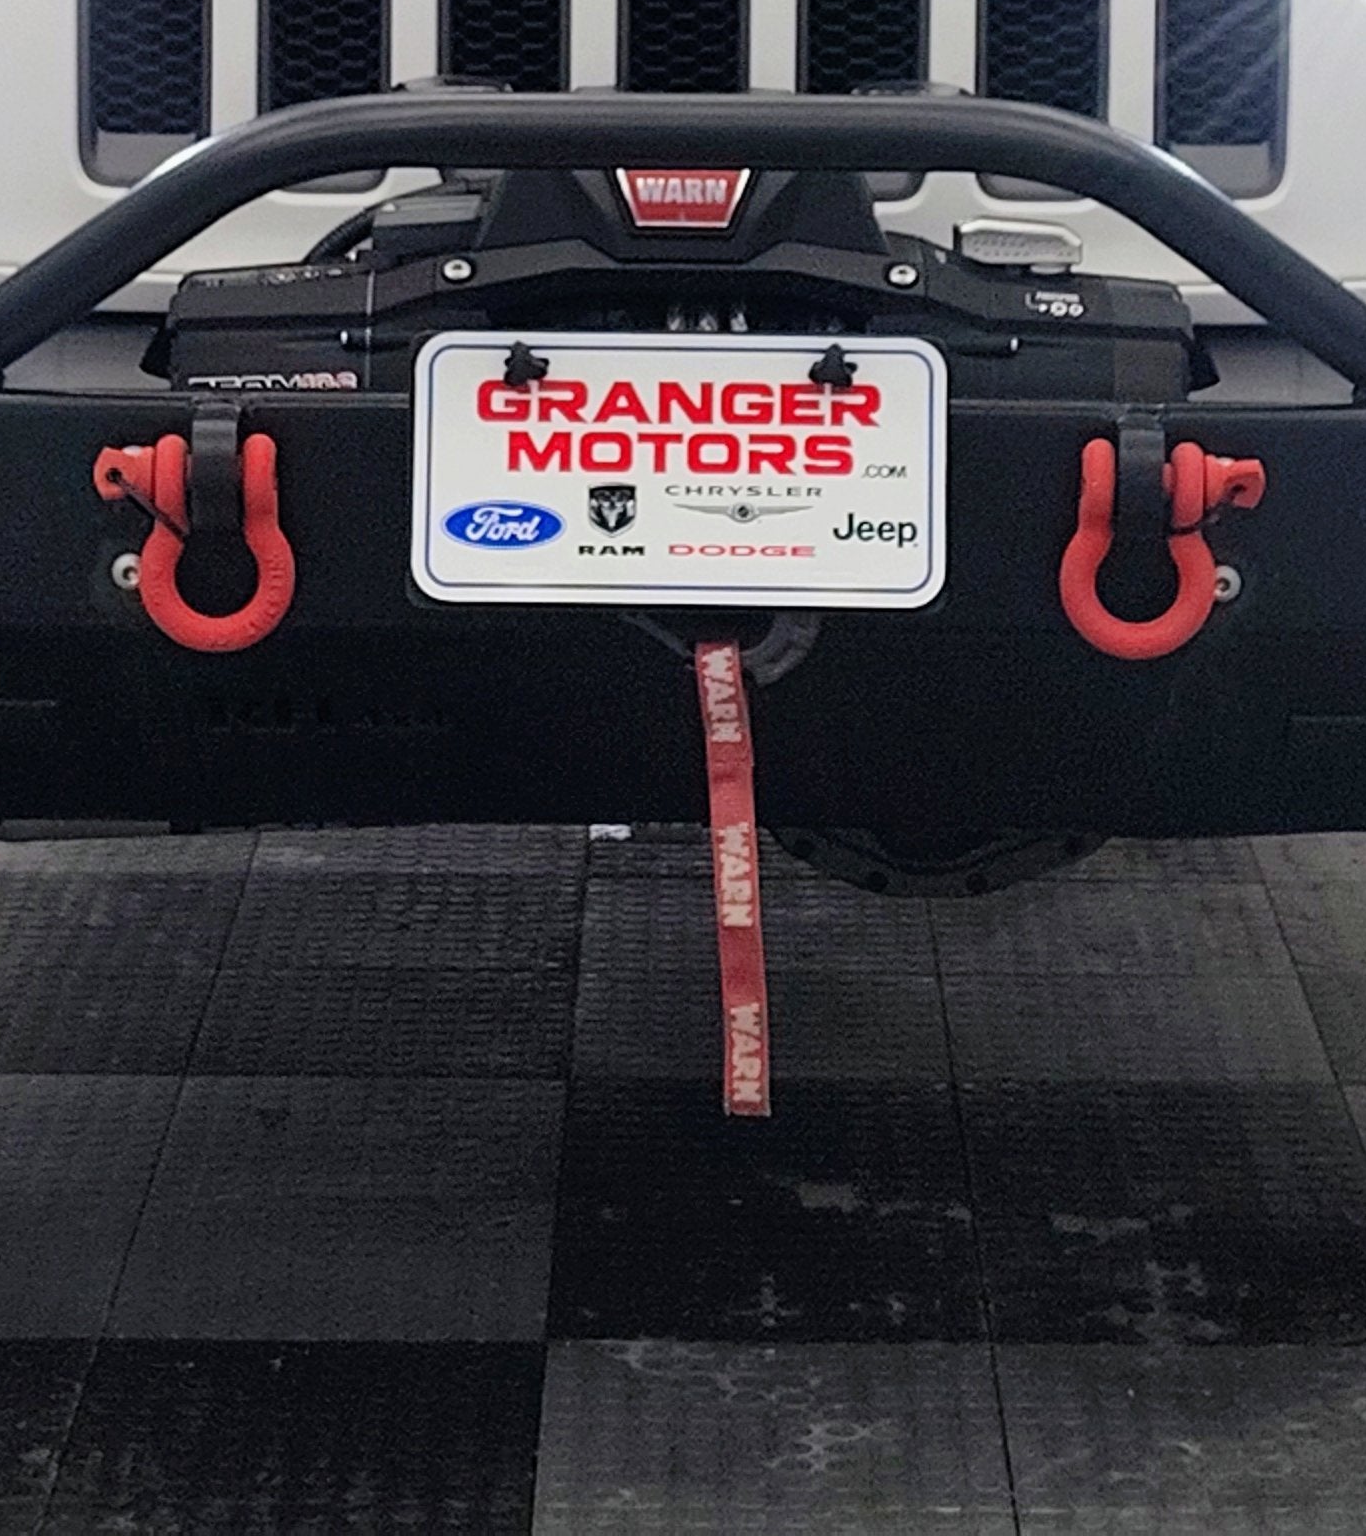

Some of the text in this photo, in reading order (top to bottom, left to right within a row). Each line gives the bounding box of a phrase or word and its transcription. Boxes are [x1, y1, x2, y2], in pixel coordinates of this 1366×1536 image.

[636, 176, 728, 204] WARN
[476, 378, 883, 427] GRANGER
[506, 430, 855, 476] MOTORS
[664, 484, 824, 498] CHRYSLER
[465, 507, 542, 543] Ford
[833, 513, 918, 548] Jeep
[578, 545, 646, 557] RAM
[668, 544, 816, 558] DODGE
[702, 647, 742, 743] WARN
[718, 822, 754, 928] WARN
[730, 1001, 762, 1103] WARN
